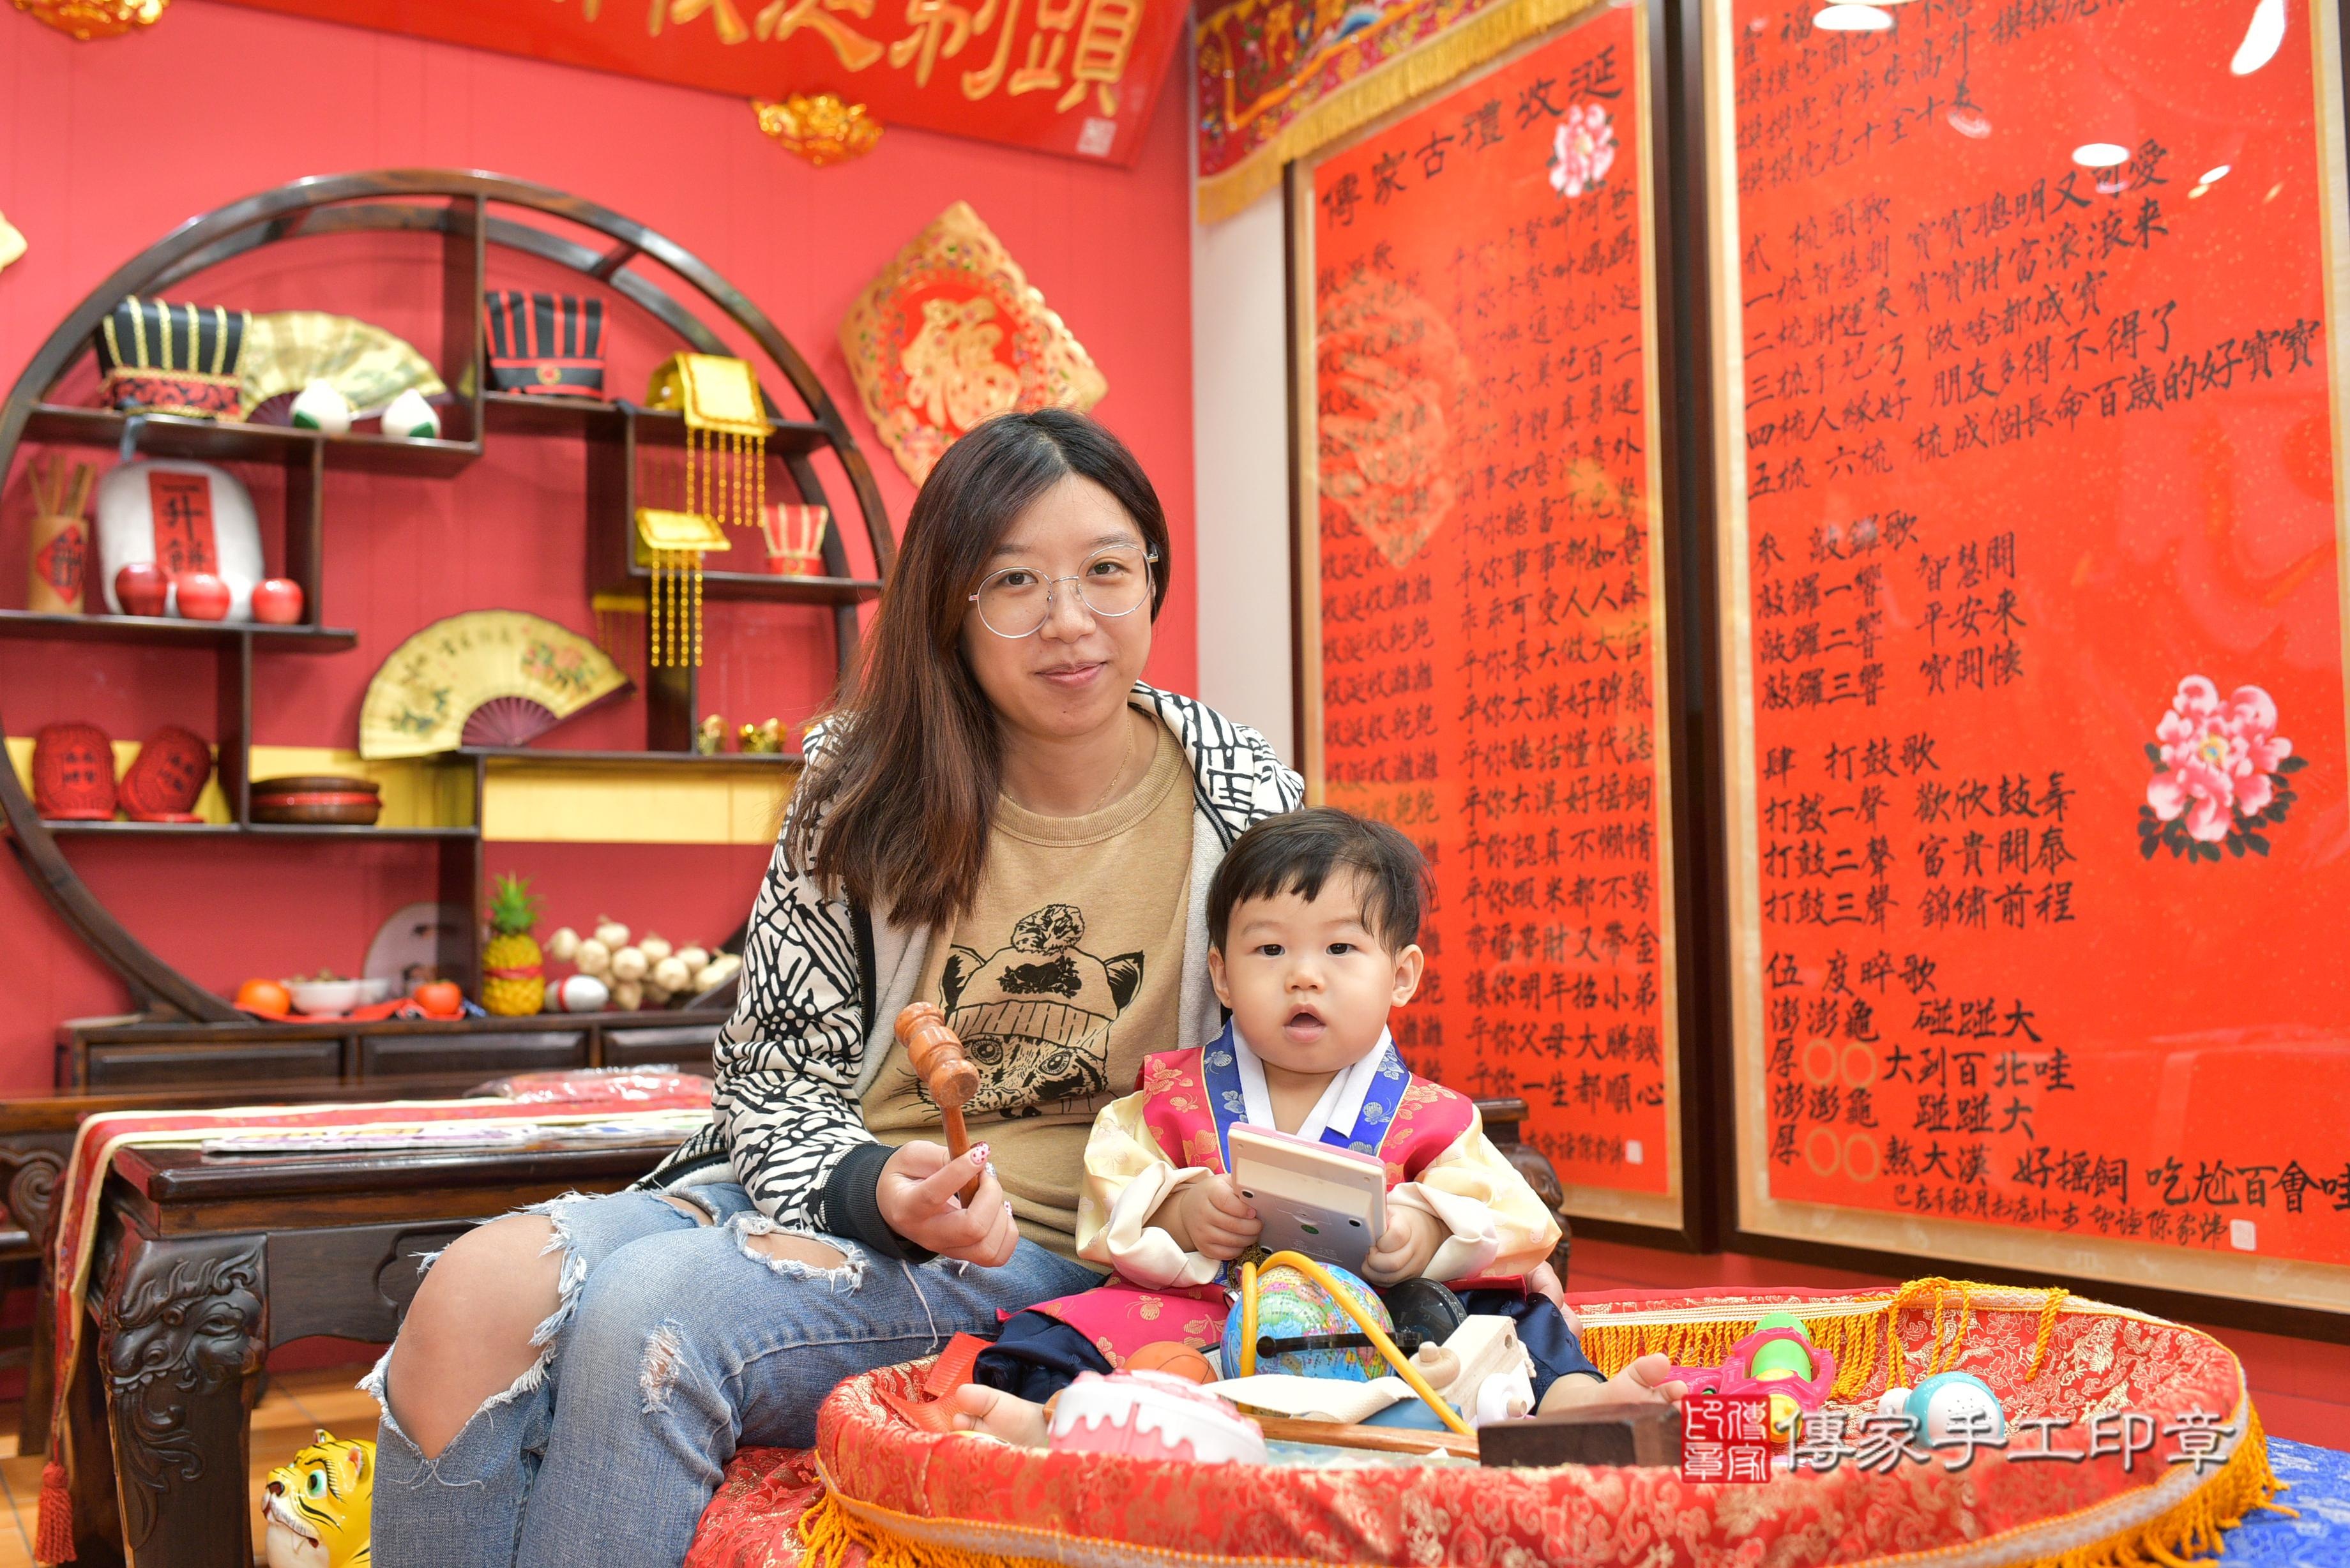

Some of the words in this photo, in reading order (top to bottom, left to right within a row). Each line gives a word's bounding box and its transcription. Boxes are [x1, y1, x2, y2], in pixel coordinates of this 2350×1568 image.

[1322, 45, 1623, 229] 傳家古禮收涎
[1930, 299, 2178, 409] 朋友多得不得了
[1747, 456, 1812, 502] 五梳
[1824, 437, 1894, 480] 六梳
[1916, 531, 2017, 592] 智慧開
[1824, 731, 1941, 783] 打鼓歌
[1764, 783, 1891, 835] 打鼓一聲
[1763, 833, 1897, 882] 打鼓二聲
[1916, 824, 2079, 878] 富貴開泰
[1764, 882, 1900, 935] 打鼓三聲
[1465, 920, 1660, 966] 帶福帶財又帶金
[1465, 968, 1659, 1016] 讓你明年招小弟
[1764, 951, 1805, 990] 伍
[1466, 1018, 1662, 1067] 乎你父母大賺錢
[1467, 1057, 1665, 1115] 乎你一生都順心
